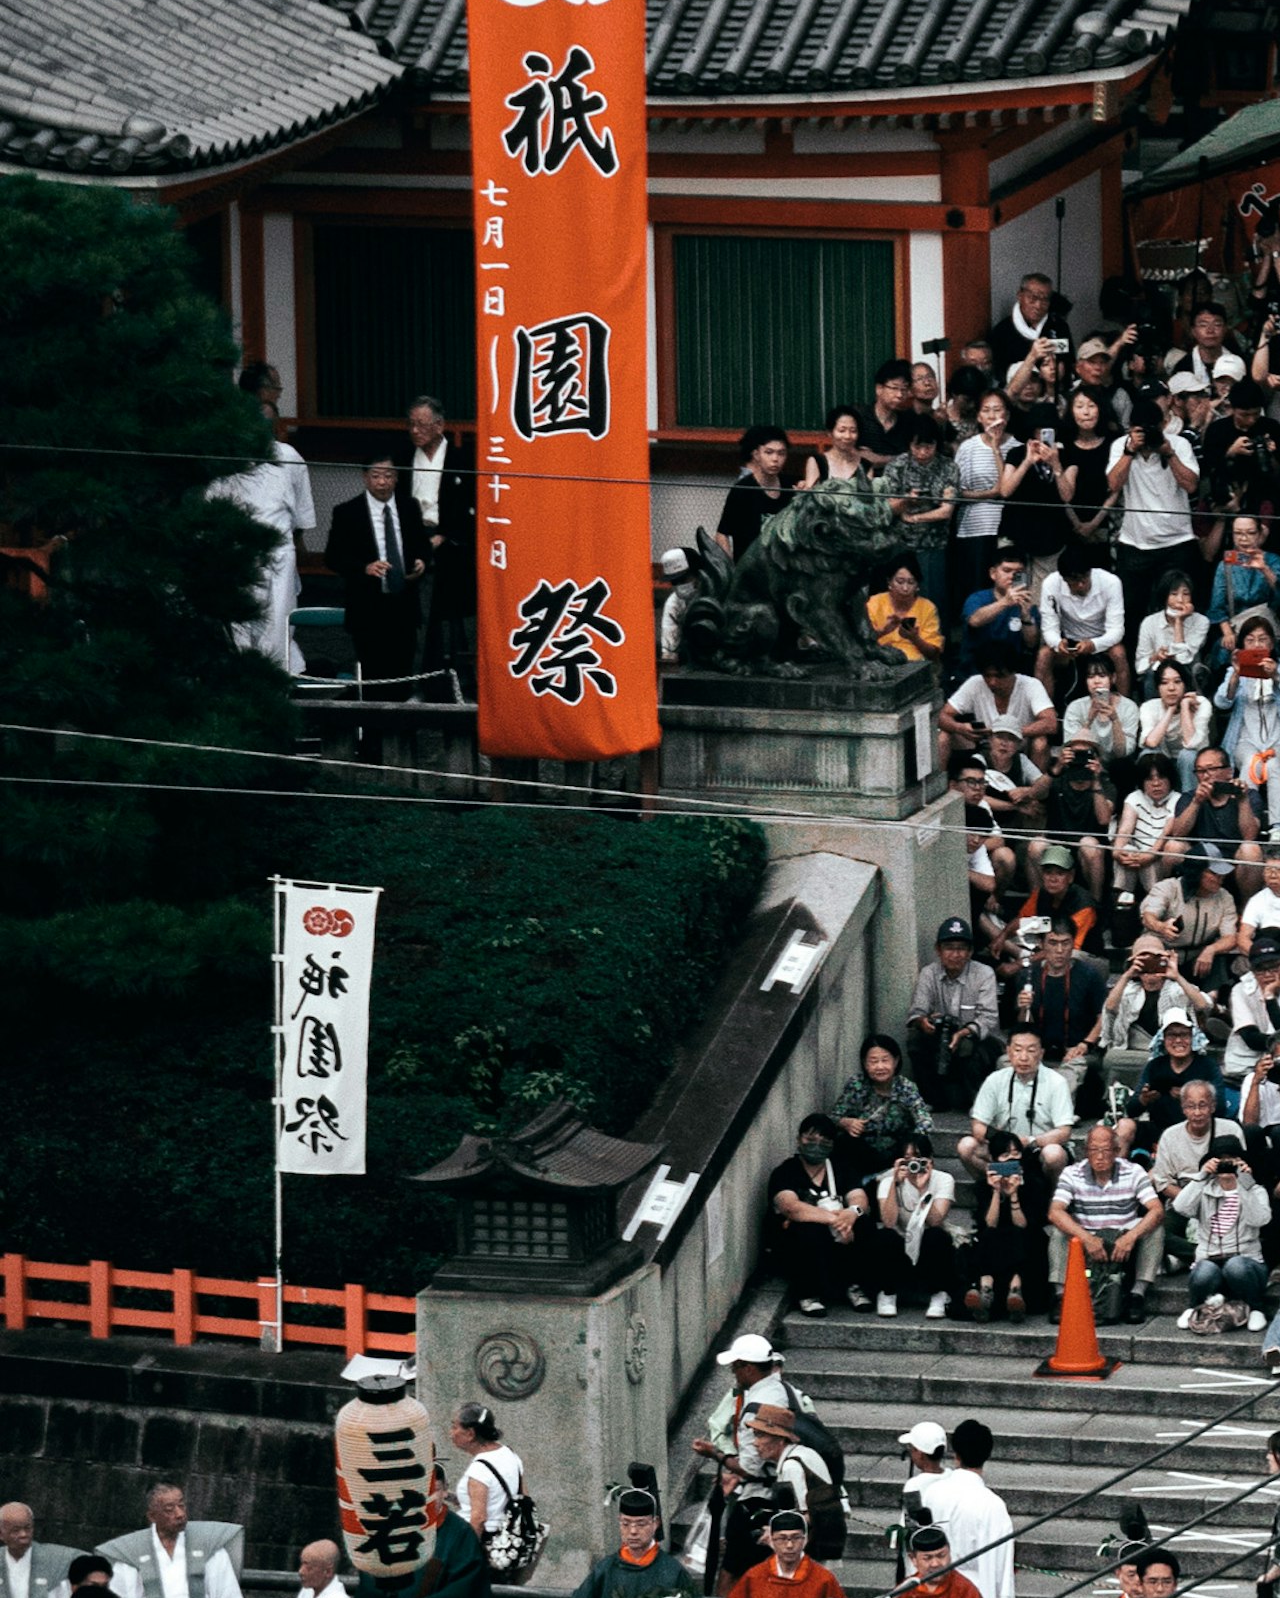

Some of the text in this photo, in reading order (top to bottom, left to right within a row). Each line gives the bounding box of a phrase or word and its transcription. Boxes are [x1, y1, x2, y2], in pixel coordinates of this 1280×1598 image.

[501, 44, 626, 707] 祇園祭
[355, 1427, 428, 1566] 三若
